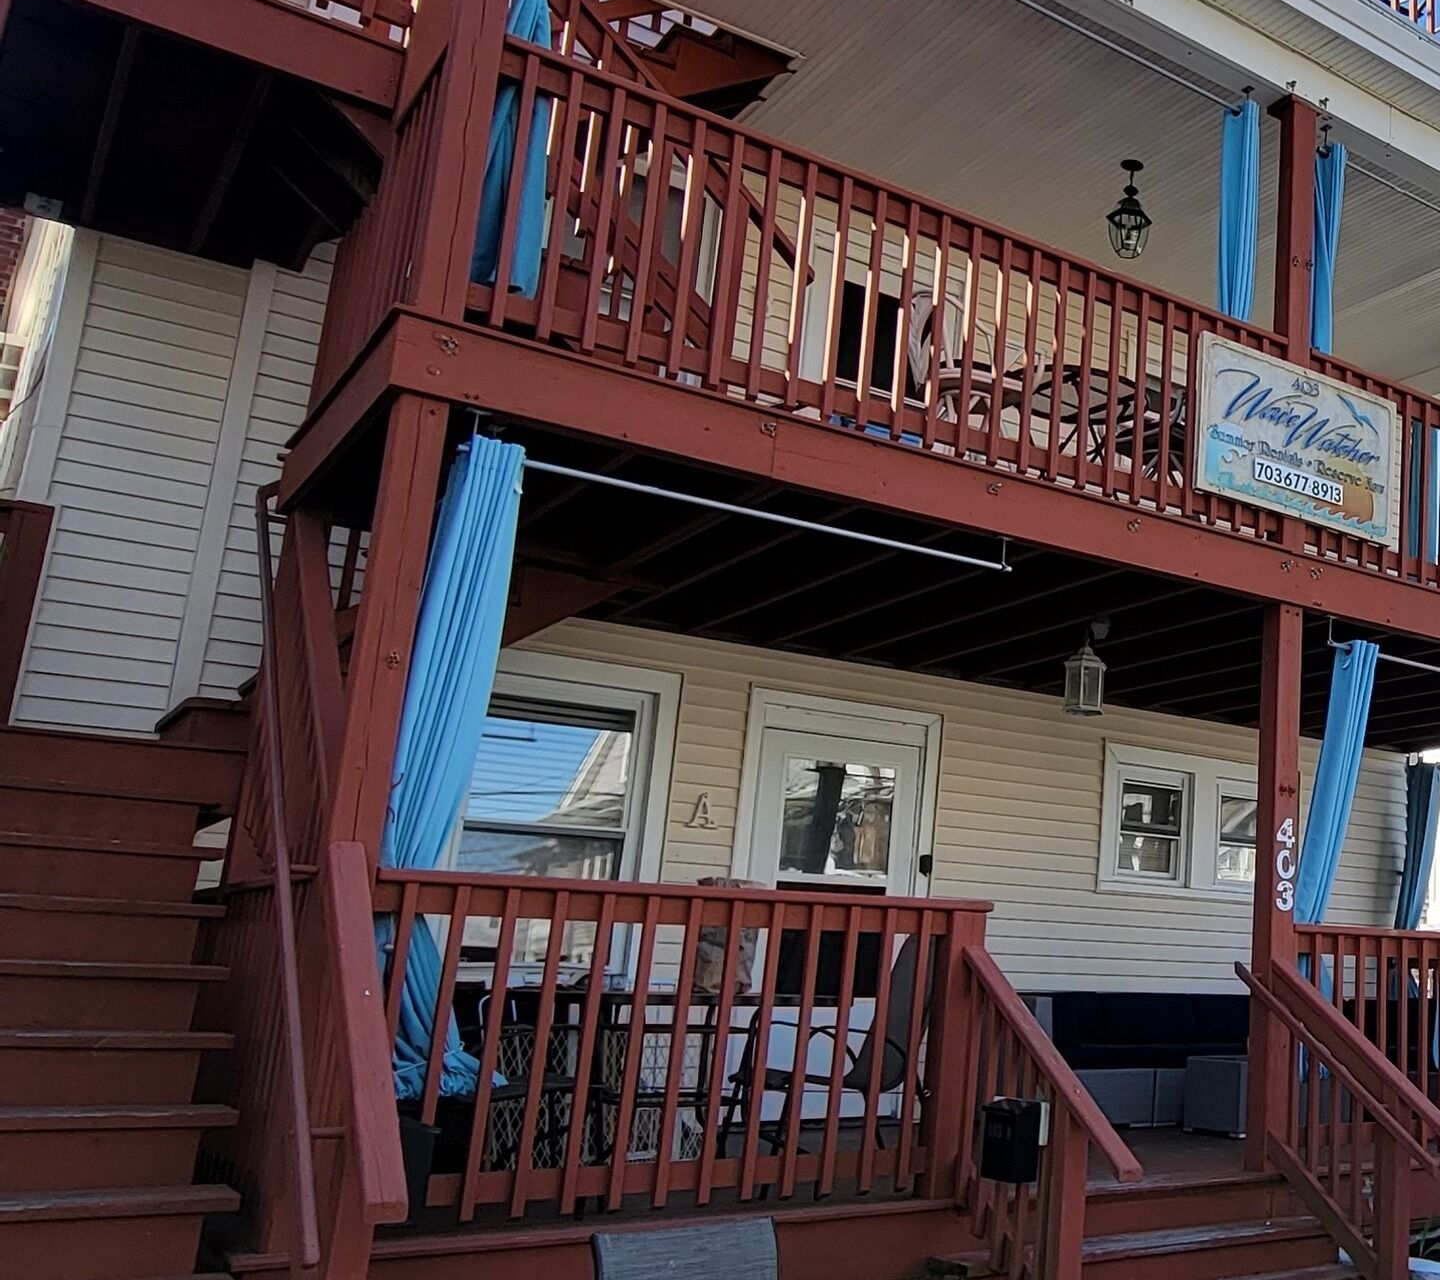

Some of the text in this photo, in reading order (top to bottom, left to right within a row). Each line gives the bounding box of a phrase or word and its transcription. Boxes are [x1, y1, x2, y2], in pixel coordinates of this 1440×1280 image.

[1292, 378, 1320, 397] 403
[1283, 401, 1380, 465] Watcher
[684, 792, 718, 830] A
[1276, 818, 1296, 911] 403
